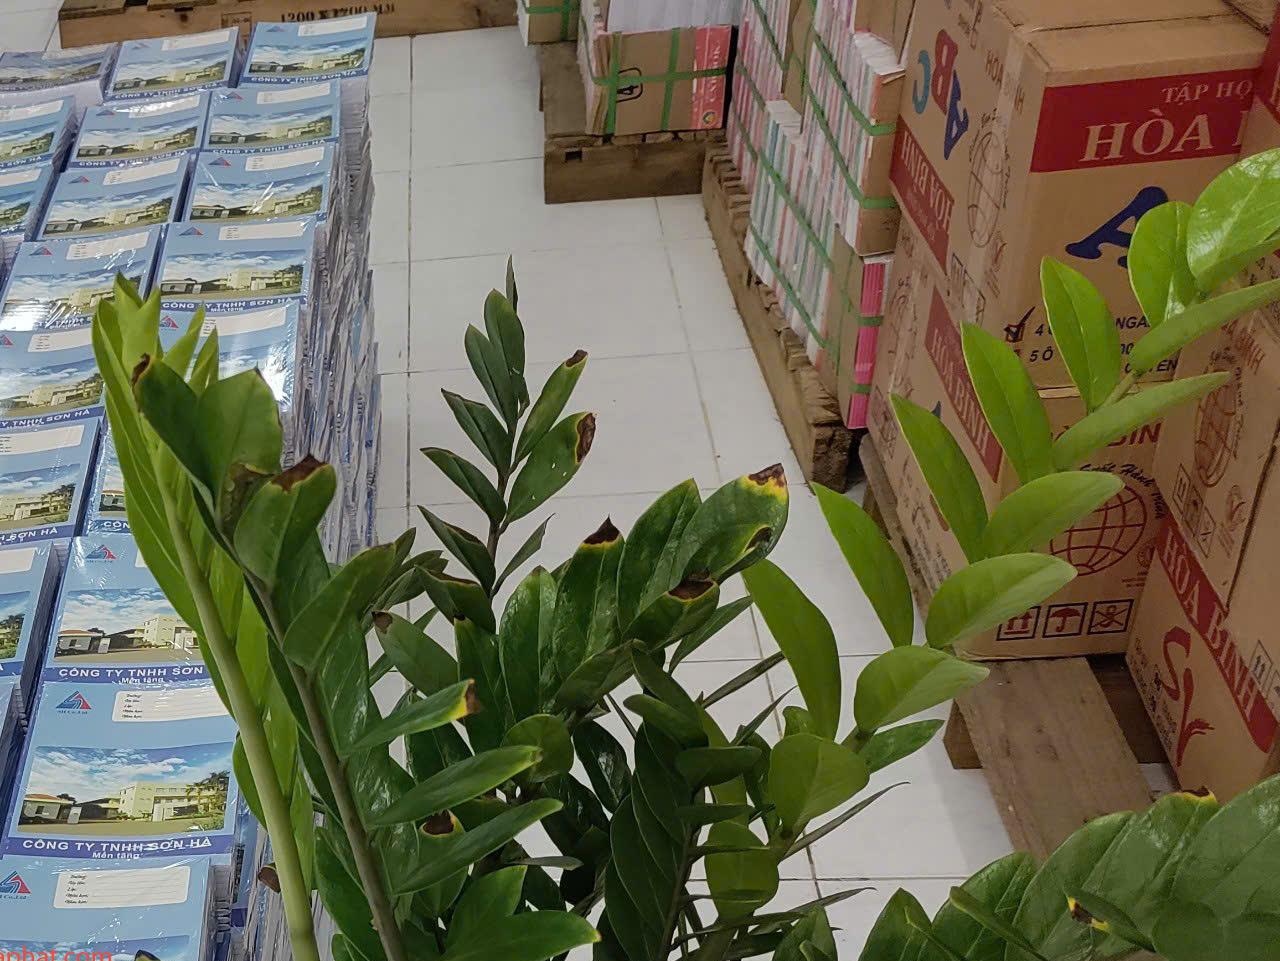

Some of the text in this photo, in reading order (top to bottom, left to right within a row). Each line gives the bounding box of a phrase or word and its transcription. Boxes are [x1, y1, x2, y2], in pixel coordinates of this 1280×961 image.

[1161, 79, 1253, 105] TẬP HỌ
[1079, 108, 1215, 162] HÒA
[22, 836, 212, 852] CÔNG TY TNHH SƠN HÀ
